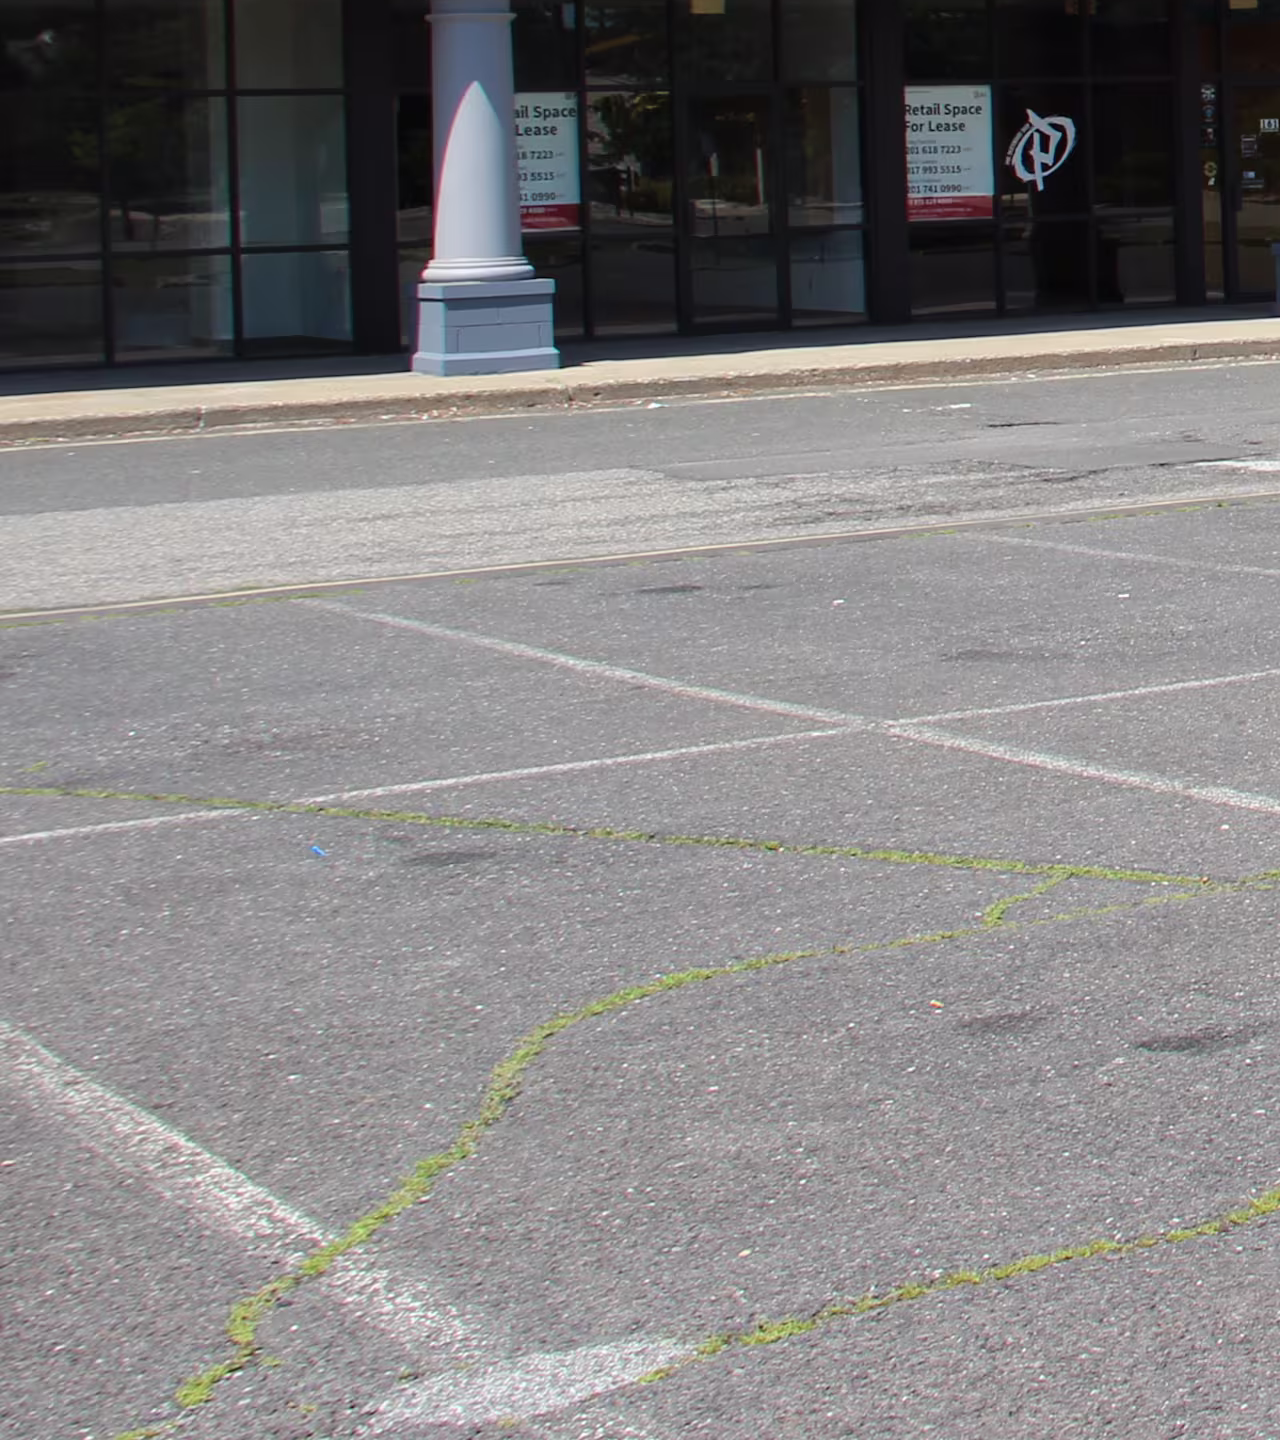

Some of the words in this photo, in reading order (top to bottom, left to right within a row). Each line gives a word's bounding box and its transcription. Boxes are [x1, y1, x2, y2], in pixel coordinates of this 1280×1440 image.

[533, 105, 577, 120] Space
[904, 103, 941, 116] Retail
[944, 104, 982, 118] Space
[515, 124, 558, 136] Lease
[904, 121, 924, 132] For
[929, 121, 966, 132] Lease
[530, 150, 554, 160] 7223
[940, 146, 961, 154] 7223
[940, 165, 961, 174] 5515
[531, 172, 555, 181] 5515
[940, 184, 961, 193] 0990
[532, 192, 556, 202] 0990
